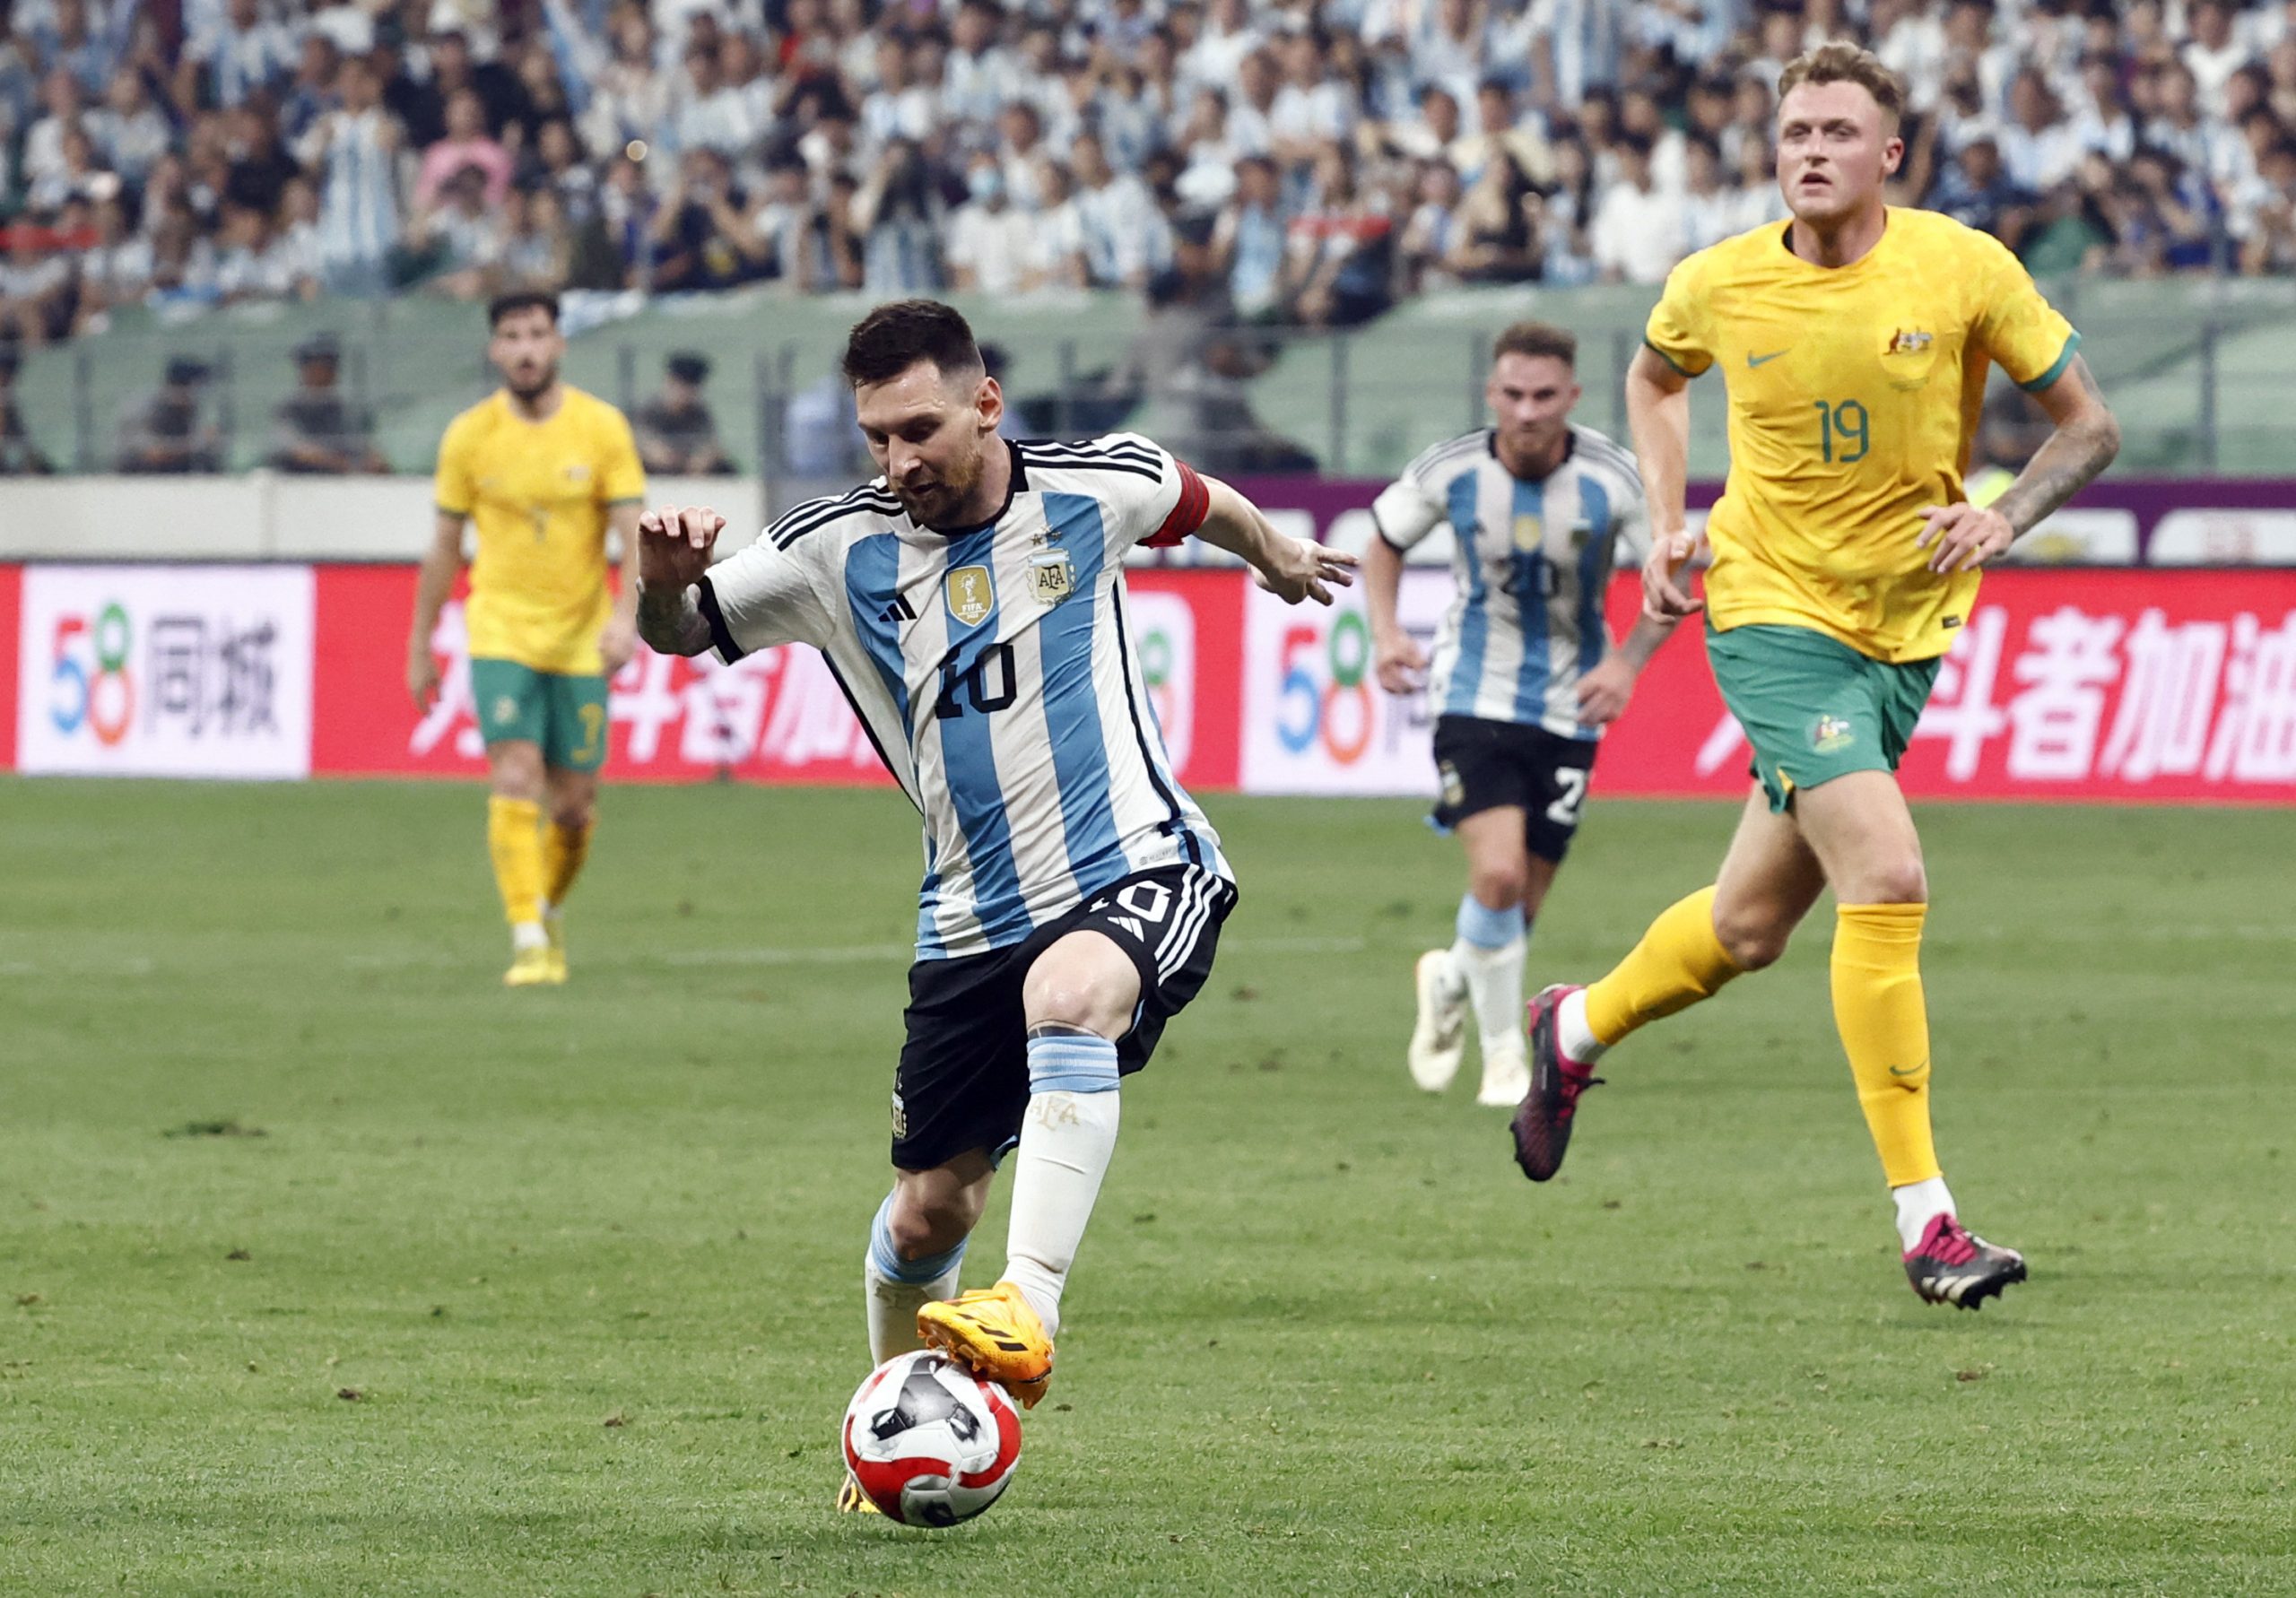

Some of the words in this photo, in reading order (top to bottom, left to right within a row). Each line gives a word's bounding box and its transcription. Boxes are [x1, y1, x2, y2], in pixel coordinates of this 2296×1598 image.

[1814, 399, 1869, 463] 19
[1039, 564, 1065, 590] AFA
[1494, 552, 1561, 599] 20
[961, 603, 983, 612] FIFA
[935, 643, 1017, 719] 10
